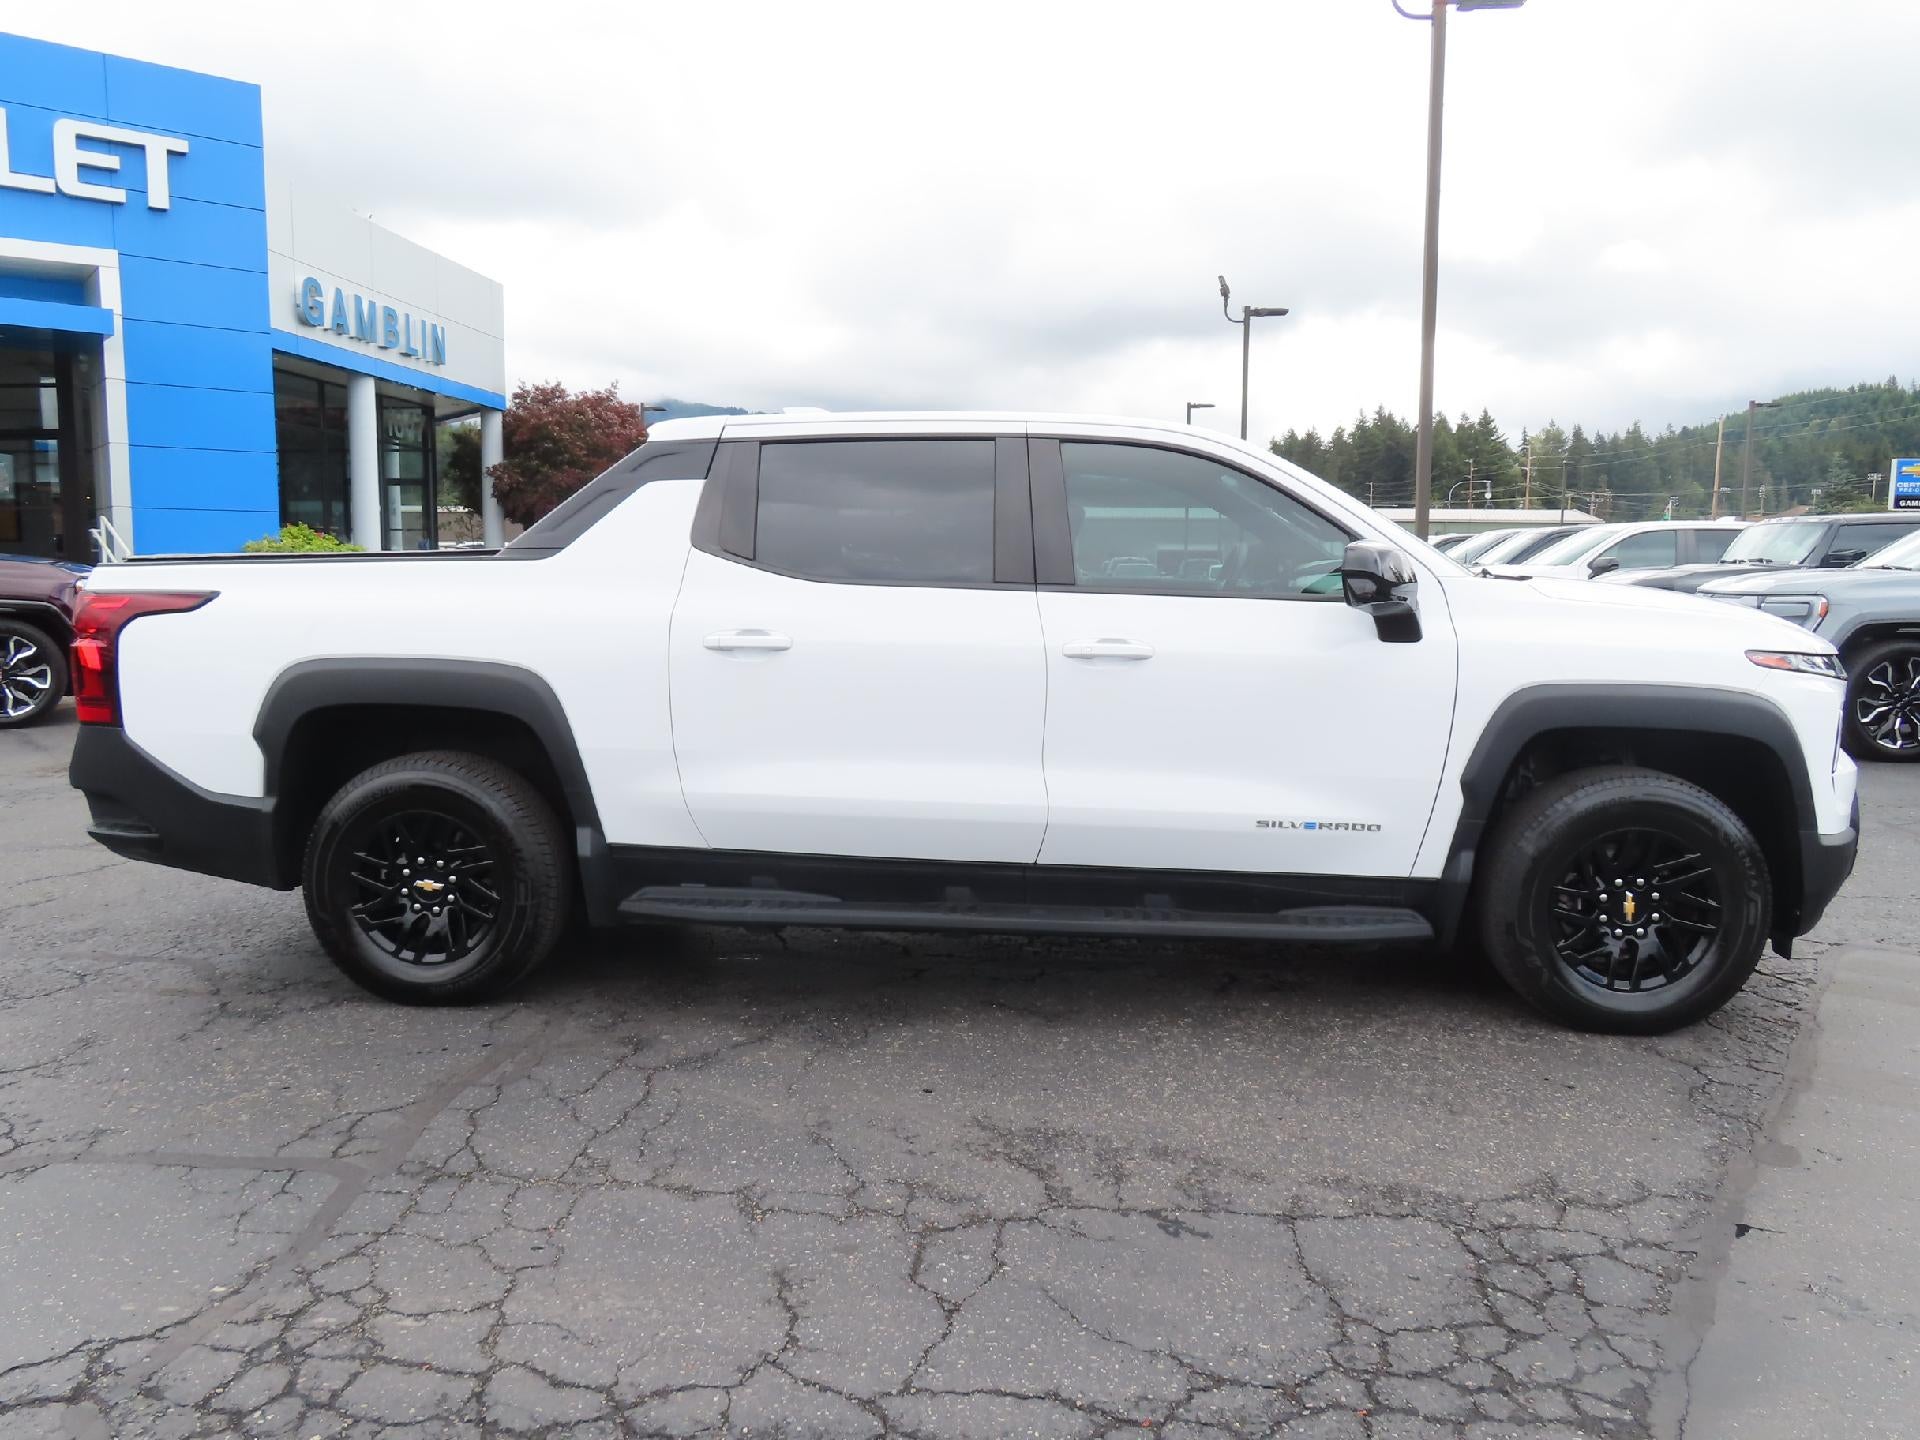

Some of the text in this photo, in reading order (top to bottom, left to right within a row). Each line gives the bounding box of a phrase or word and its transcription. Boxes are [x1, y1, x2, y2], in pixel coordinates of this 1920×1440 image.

[0, 107, 189, 210] LET
[301, 276, 446, 366] GAMBLIN
[1255, 820, 1382, 832] SILVERADO
